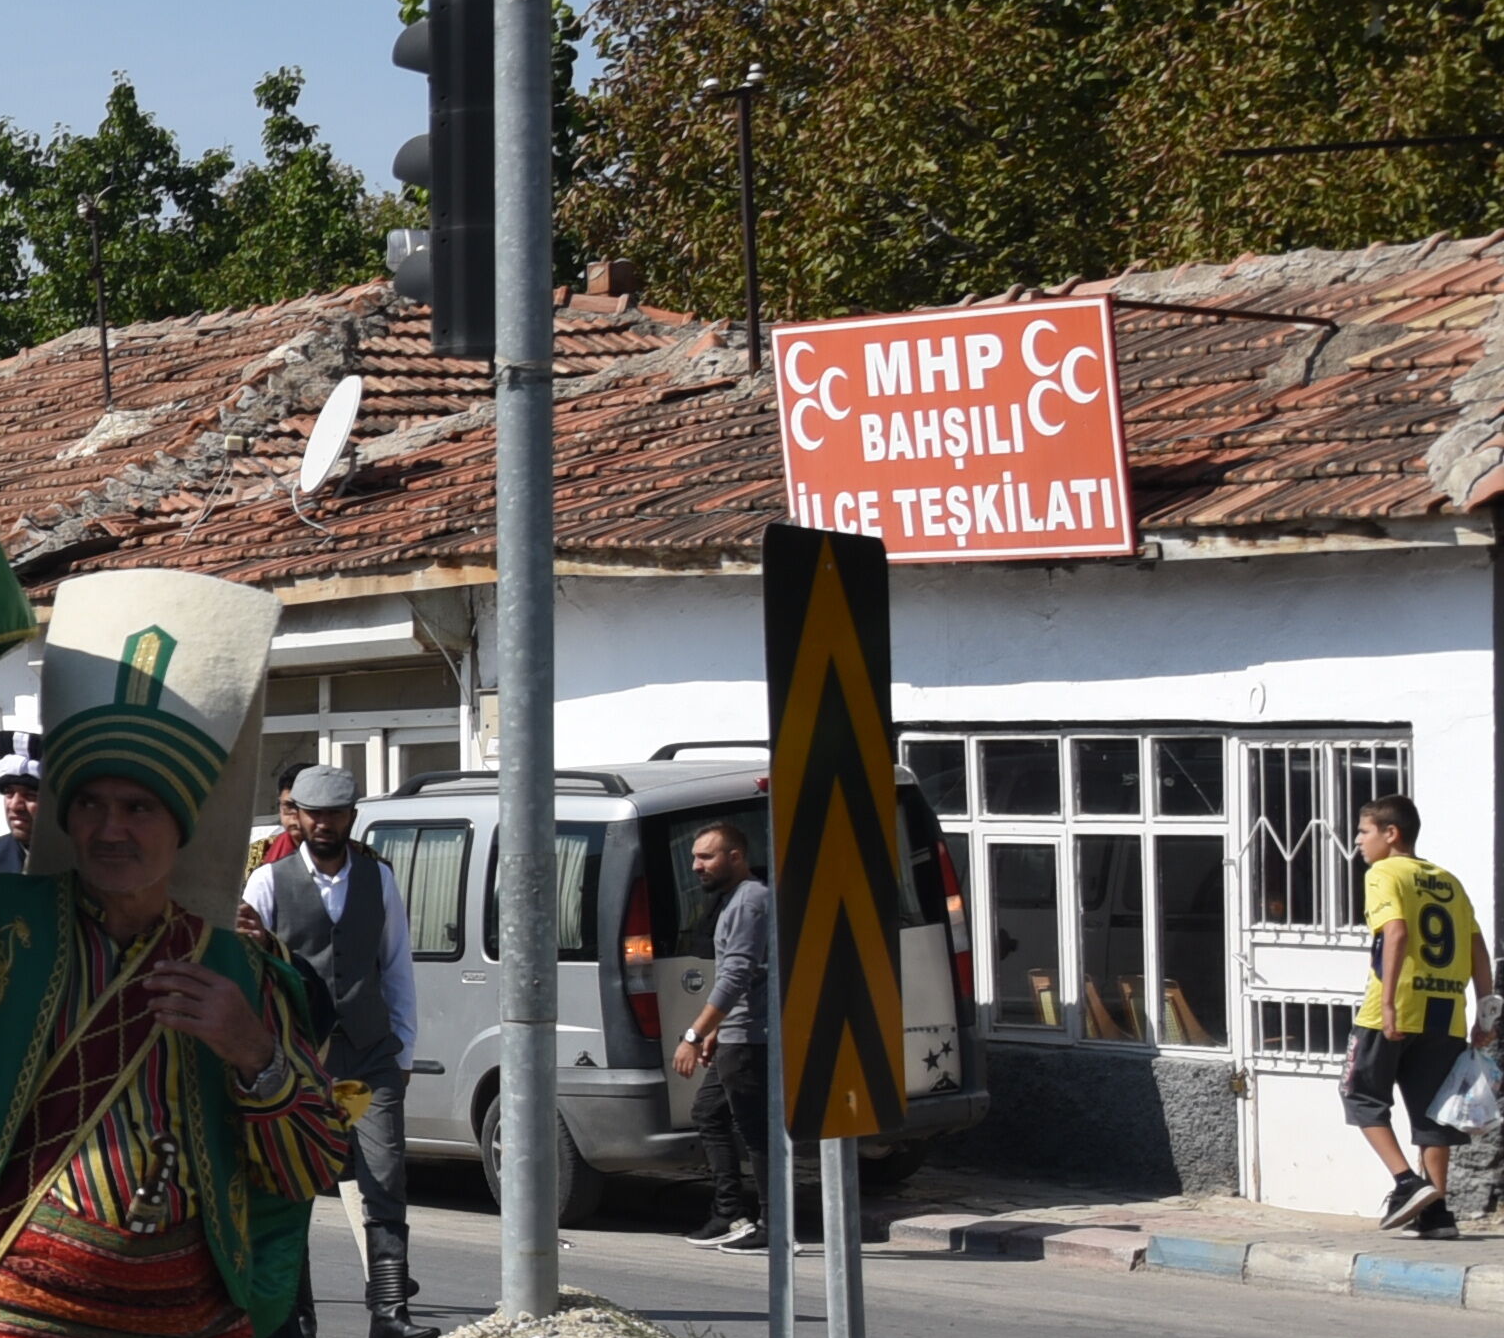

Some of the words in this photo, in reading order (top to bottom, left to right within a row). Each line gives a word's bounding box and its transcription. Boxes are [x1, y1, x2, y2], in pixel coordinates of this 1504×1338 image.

[863, 333, 1003, 398] MHP
[859, 403, 1025, 470] BAHŞILI
[892, 470, 1116, 548] TEŞKİLATI
[1418, 902, 1456, 969] 9
